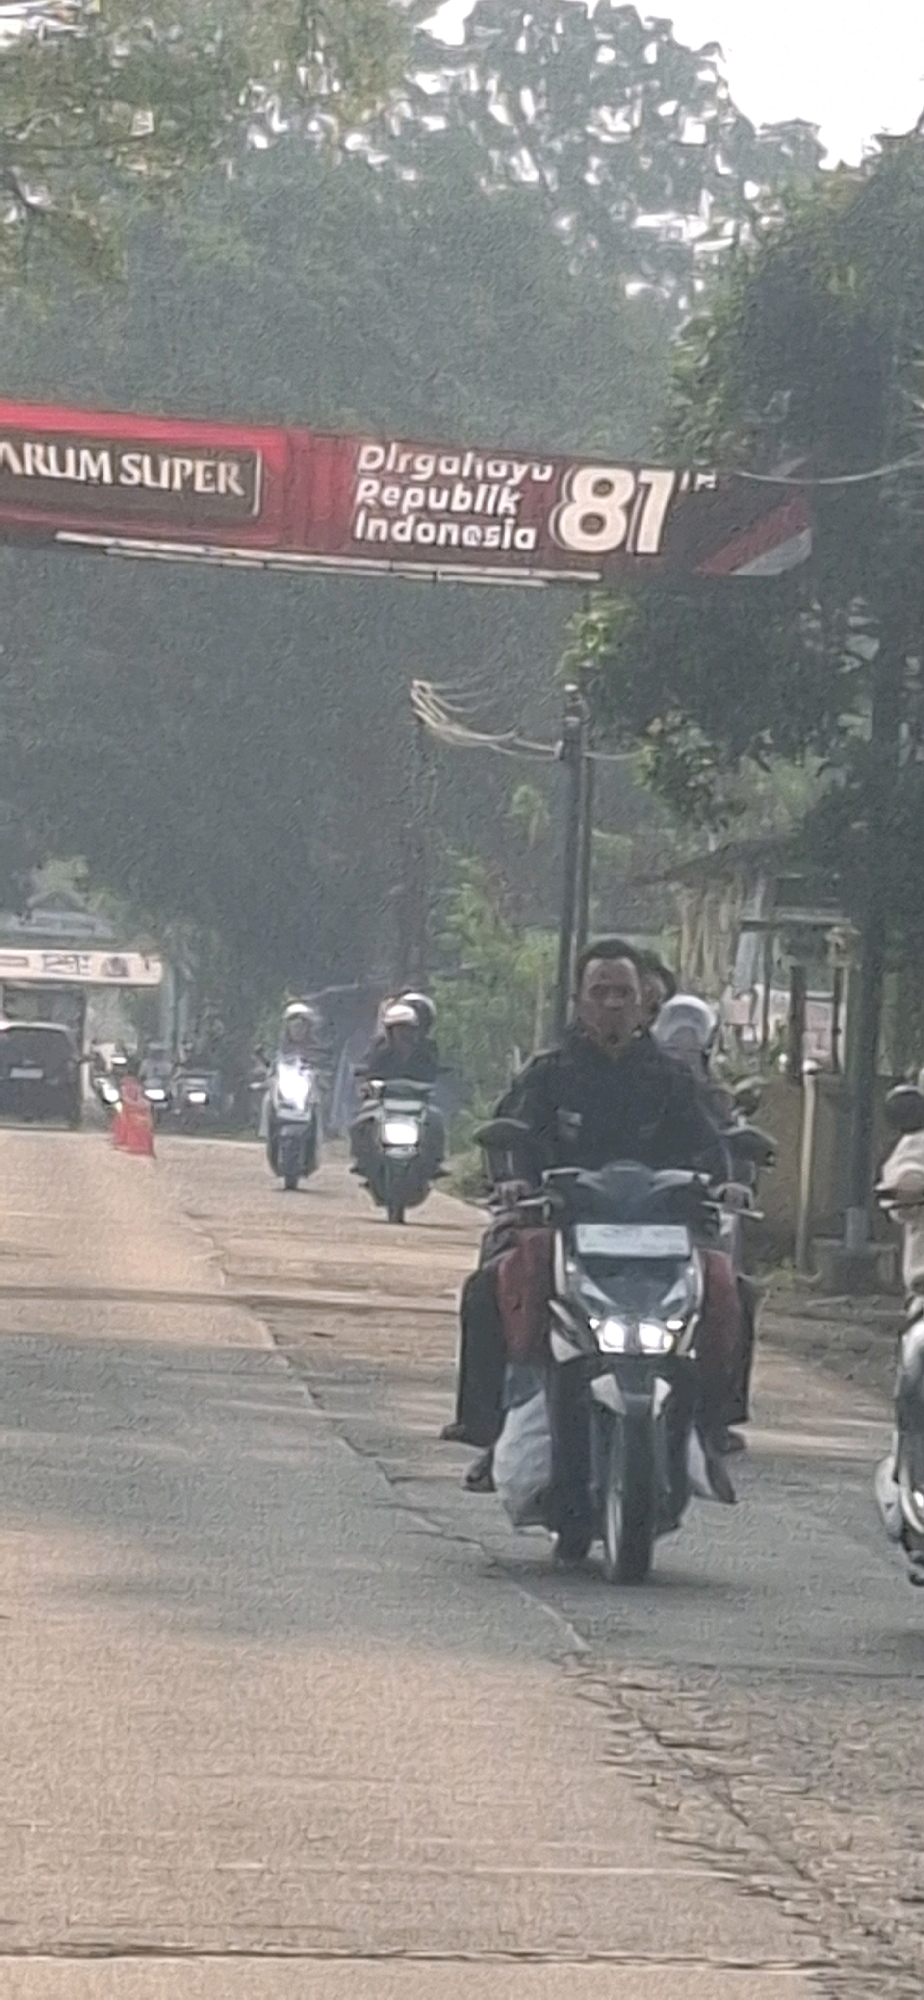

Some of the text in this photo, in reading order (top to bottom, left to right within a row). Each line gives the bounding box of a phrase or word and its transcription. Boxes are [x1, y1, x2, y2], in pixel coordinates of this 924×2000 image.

[119, 453, 246, 496] SUPER
[356, 477, 522, 517] Republik
[354, 508, 538, 551] Indonesia
